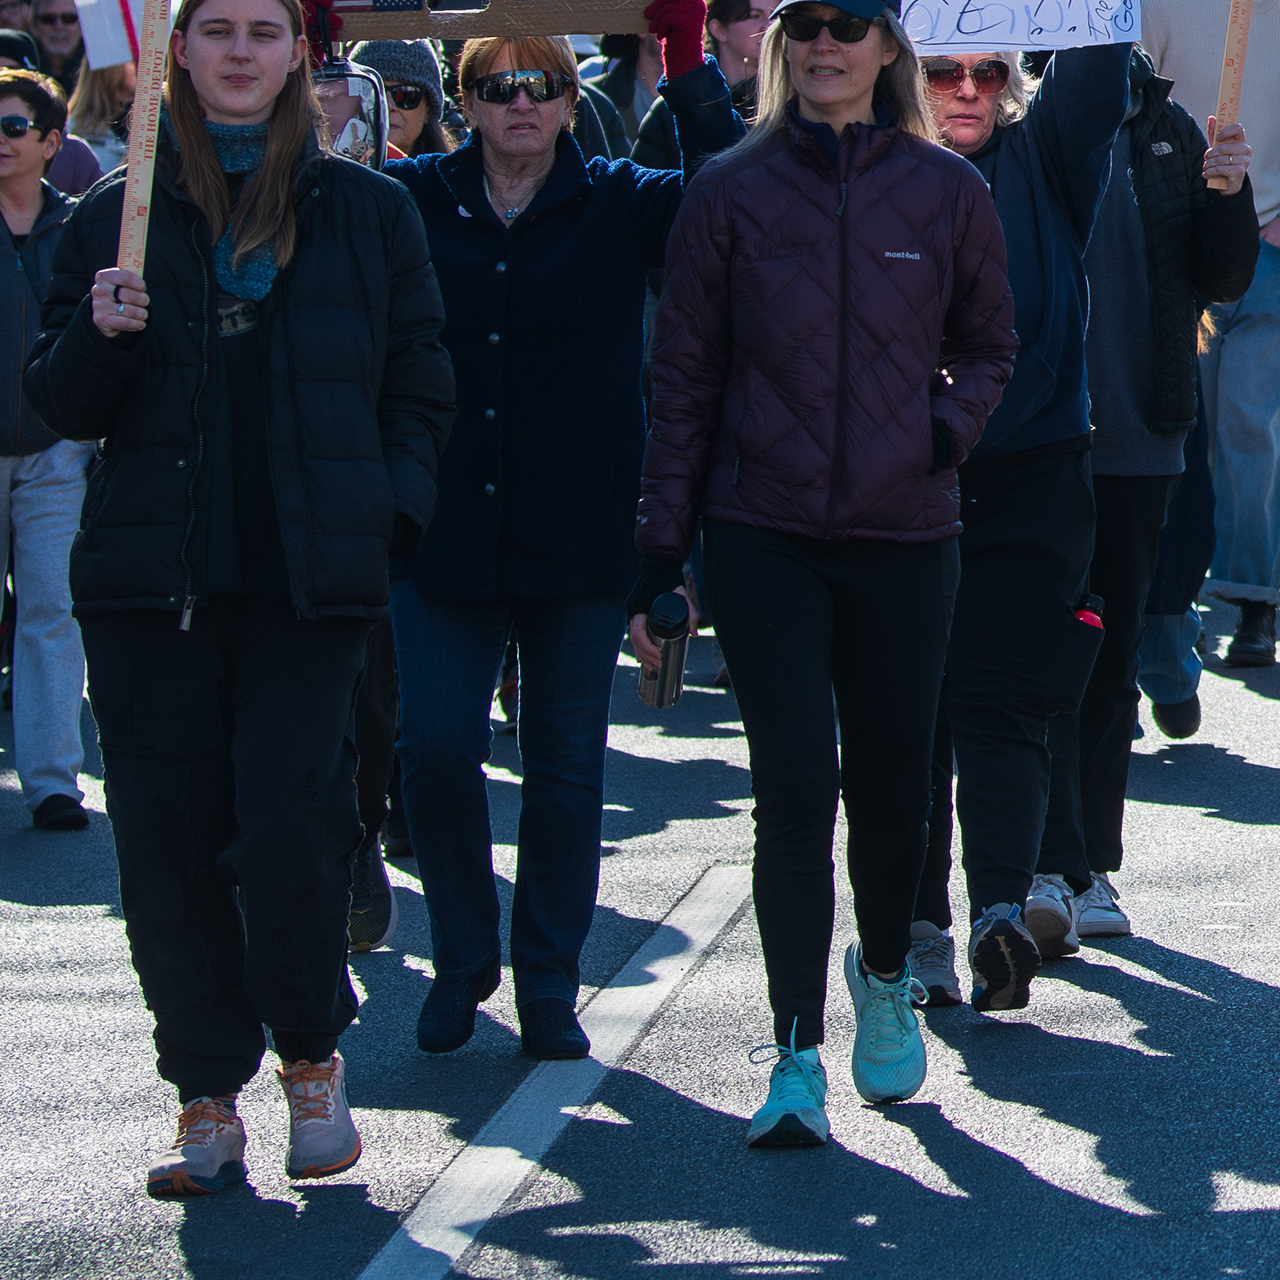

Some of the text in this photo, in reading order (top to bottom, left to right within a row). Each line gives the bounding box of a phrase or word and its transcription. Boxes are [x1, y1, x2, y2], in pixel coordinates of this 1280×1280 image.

[144, 47, 164, 161] THE HOME DEPOT
